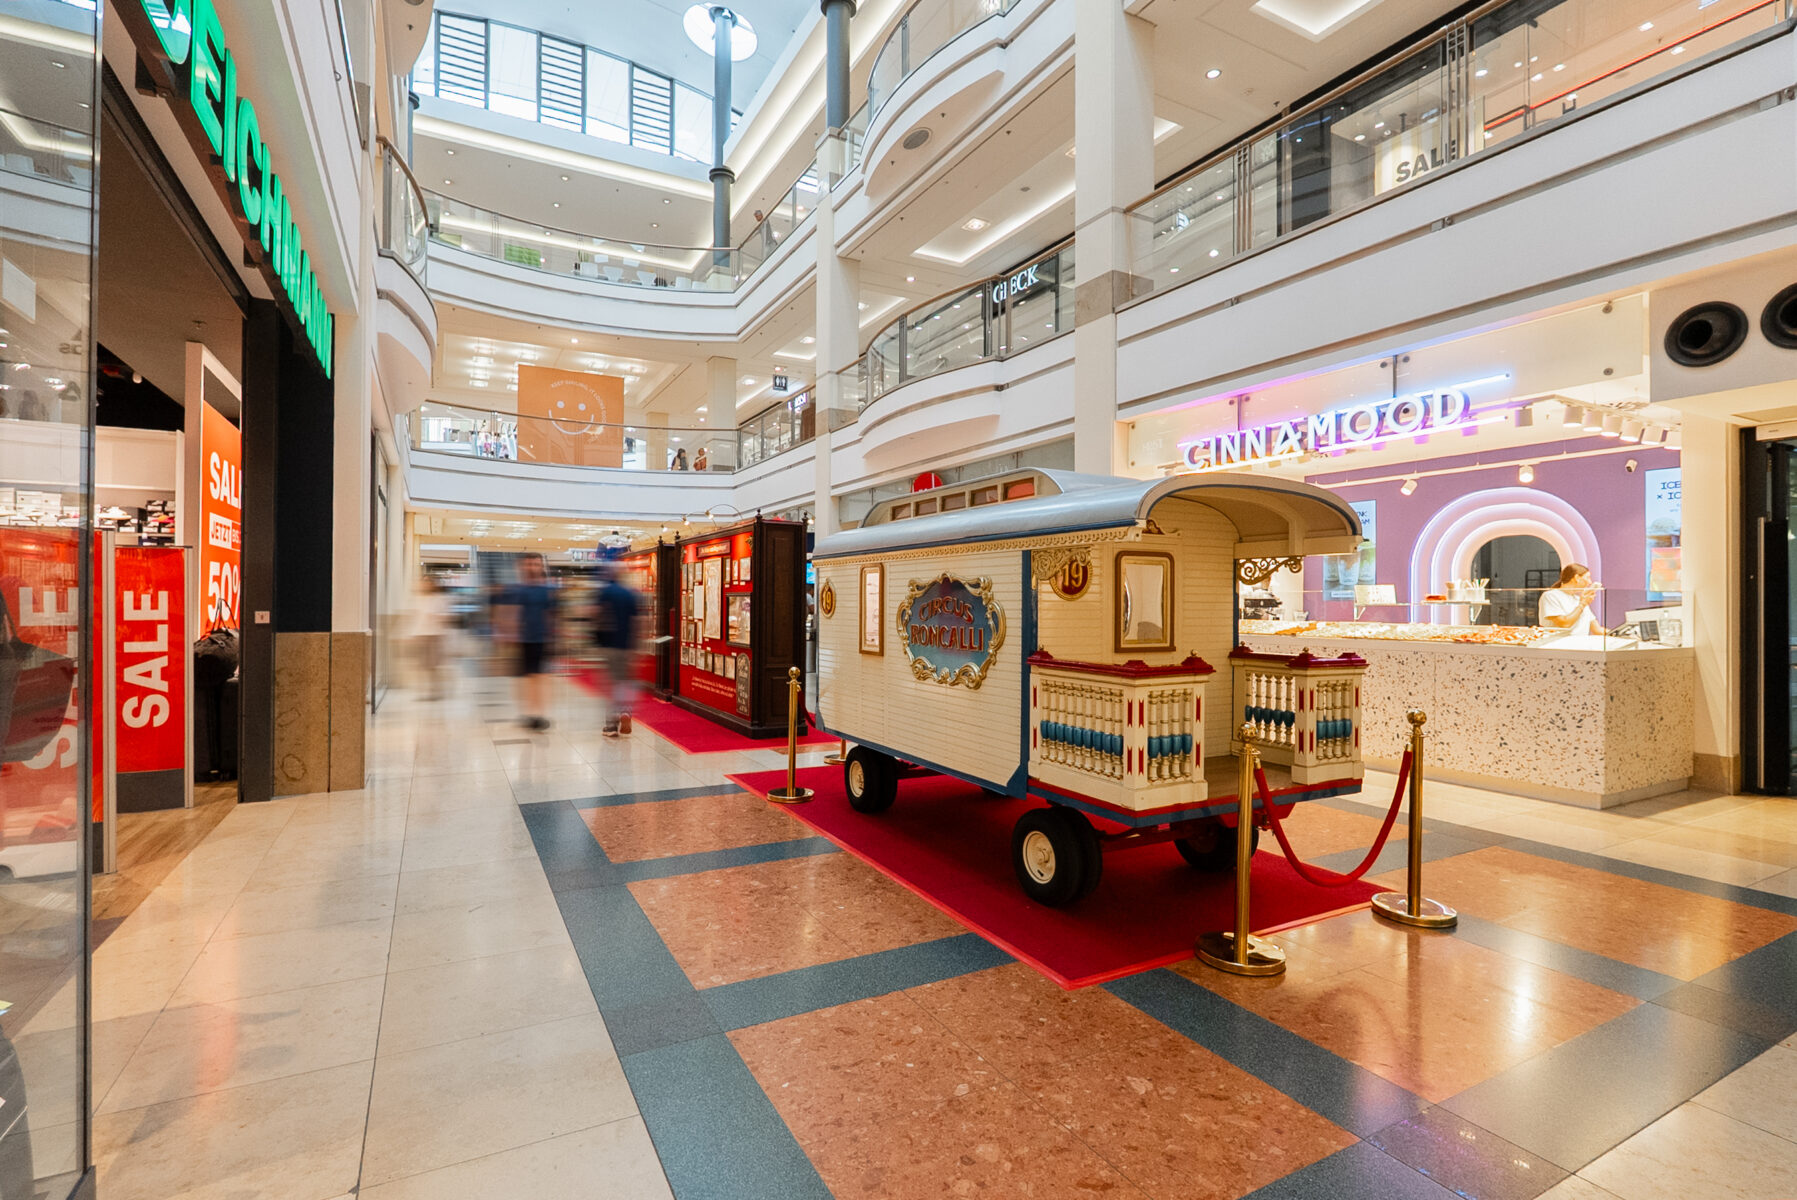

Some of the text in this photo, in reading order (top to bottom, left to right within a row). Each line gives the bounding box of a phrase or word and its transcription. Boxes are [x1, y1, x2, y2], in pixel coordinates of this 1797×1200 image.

[1183, 390, 1467, 470] CINNAMOOD
[211, 520, 231, 543] JETZT
[1061, 560, 1084, 588] 19
[821, 589, 835, 611] 19
[918, 595, 974, 624] CIRCUS
[909, 623, 984, 652] RONCALLI
[122, 590, 170, 728] SALE
